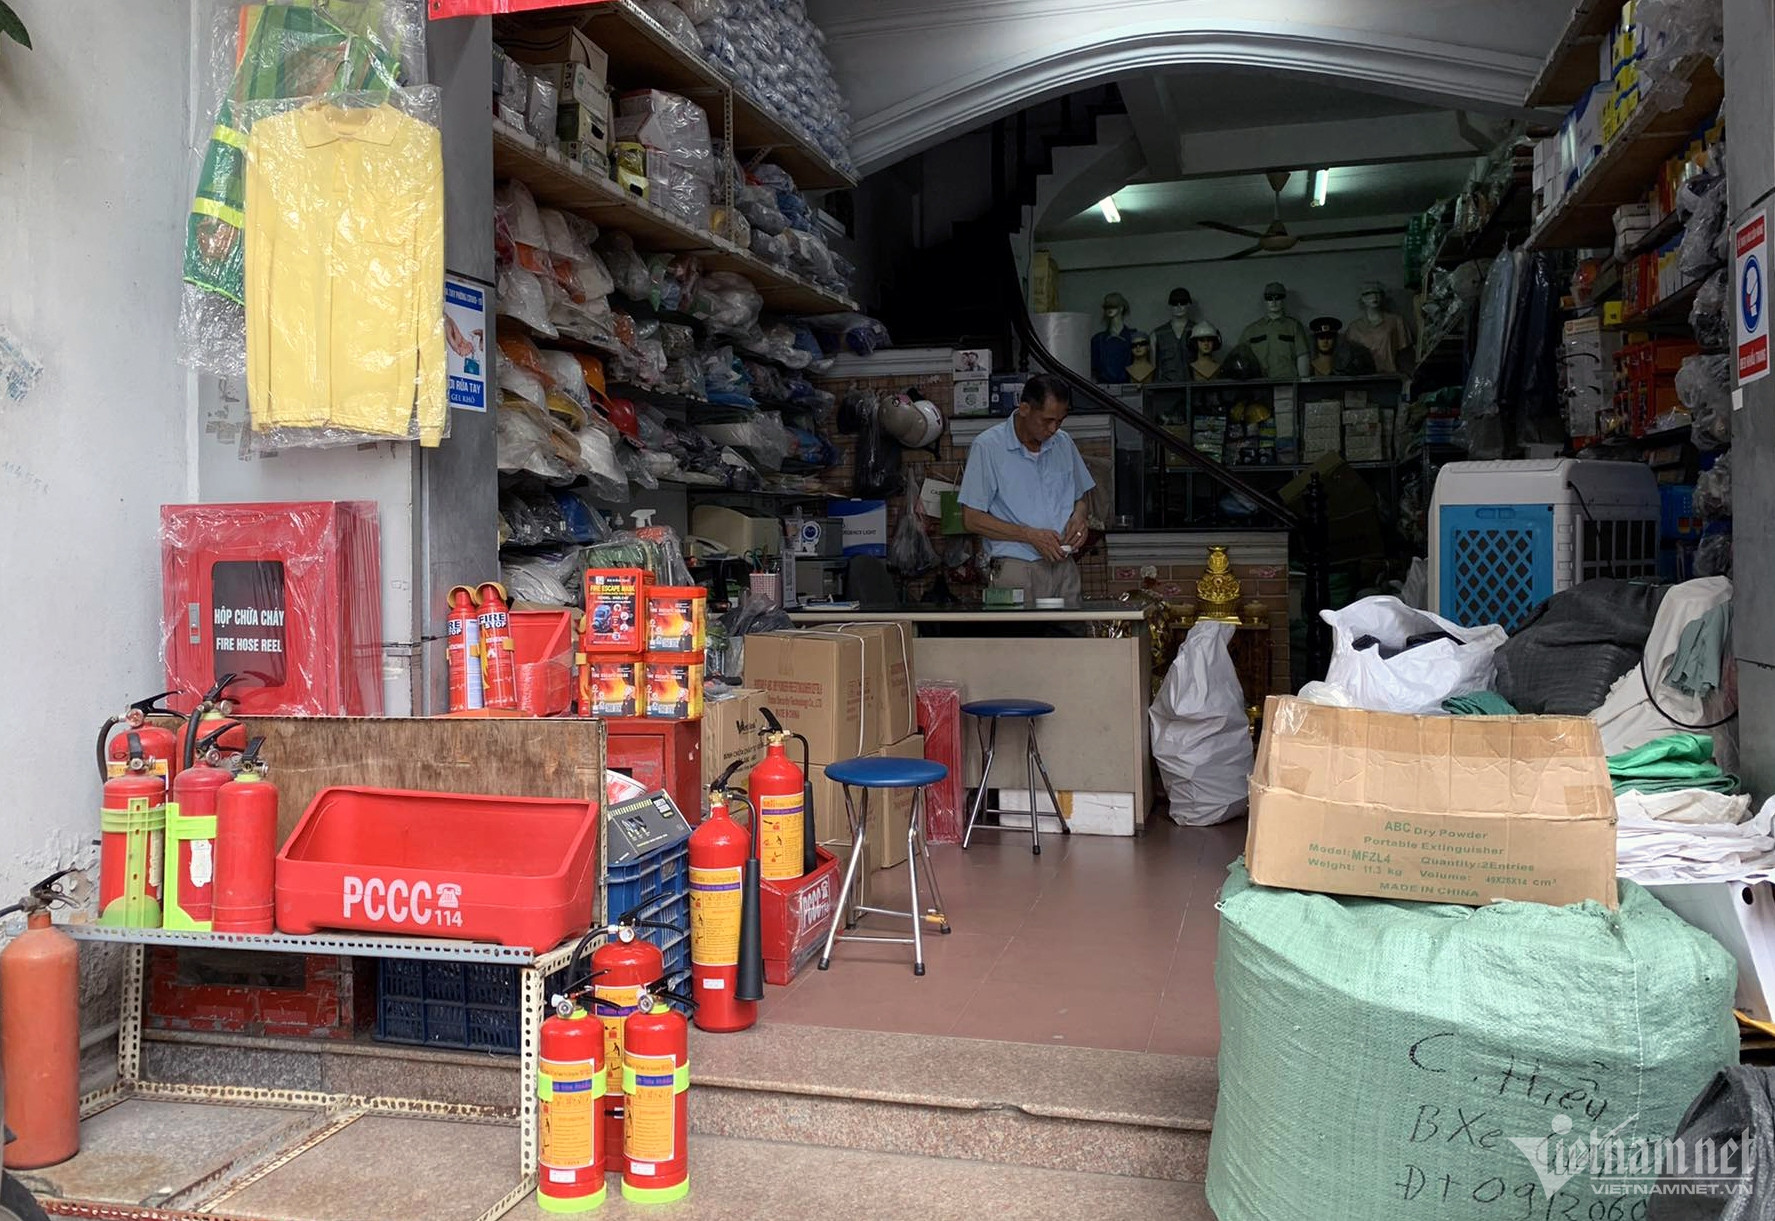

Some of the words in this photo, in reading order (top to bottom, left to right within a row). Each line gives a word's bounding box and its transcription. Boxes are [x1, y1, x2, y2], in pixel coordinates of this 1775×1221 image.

[456, 376, 469, 392] RỬA
[469, 382, 481, 394] TAY
[590, 584, 602, 593] FIRE
[602, 584, 620, 593] ESCAPE
[620, 584, 635, 593] MASK
[214, 605, 232, 628] HỘP
[234, 606, 259, 626] CHỮA
[260, 606, 284, 626] CHÁY
[478, 612, 506, 624] FIRE
[484, 621, 506, 629] STOP
[216, 637, 235, 651] FIRE
[236, 638, 259, 652] HOSE
[261, 638, 282, 653] REEL
[1384, 821, 1411, 833] ABC
[1413, 826, 1437, 838] Dry
[1439, 829, 1488, 840] Powder
[1363, 836, 1418, 850] Portable
[1421, 842, 1504, 855] Extinguisher
[1308, 858, 1355, 872] Weight:
[1387, 867, 1403, 877] kg
[1420, 869, 1471, 881] Volume:
[1380, 882, 1418, 893] MADE
[1420, 886, 1434, 894] IN
[1437, 887, 1479, 898] CHINA
[343, 875, 432, 926] PCCC
[435, 910, 463, 927] 114
